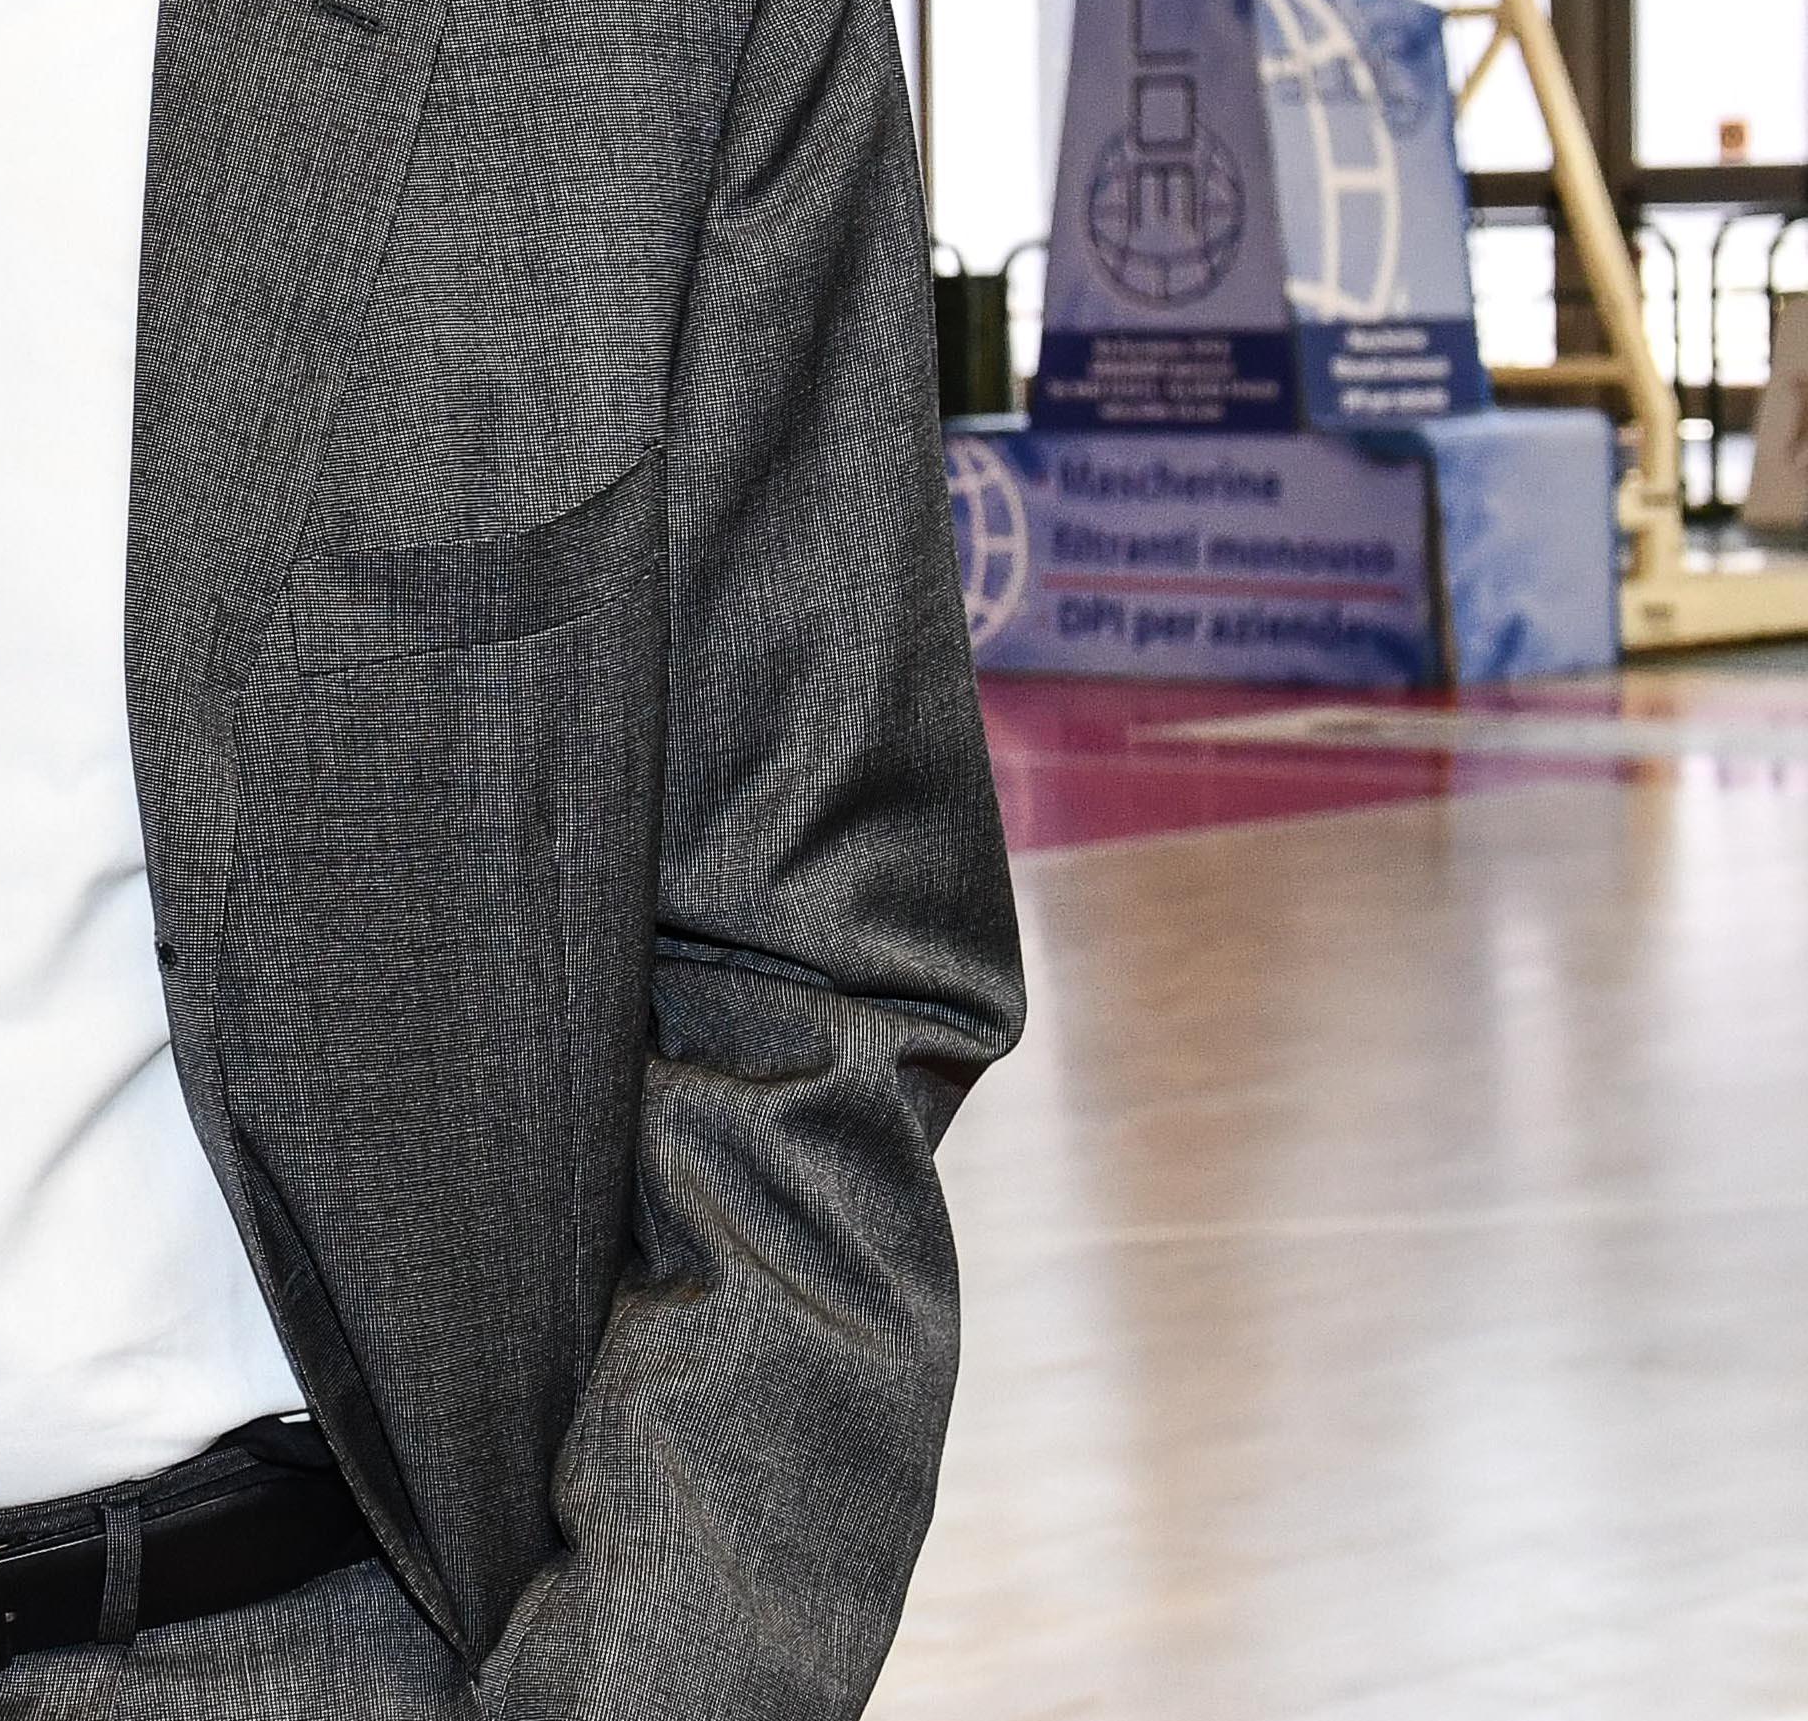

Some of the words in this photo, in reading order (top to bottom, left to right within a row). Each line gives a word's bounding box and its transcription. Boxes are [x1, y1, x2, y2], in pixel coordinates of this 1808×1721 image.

[1057, 454, 1283, 501] Mascherine
[1205, 536, 1396, 572] monouso
[1057, 597, 1125, 635] DPI
[1131, 608, 1196, 651] per
